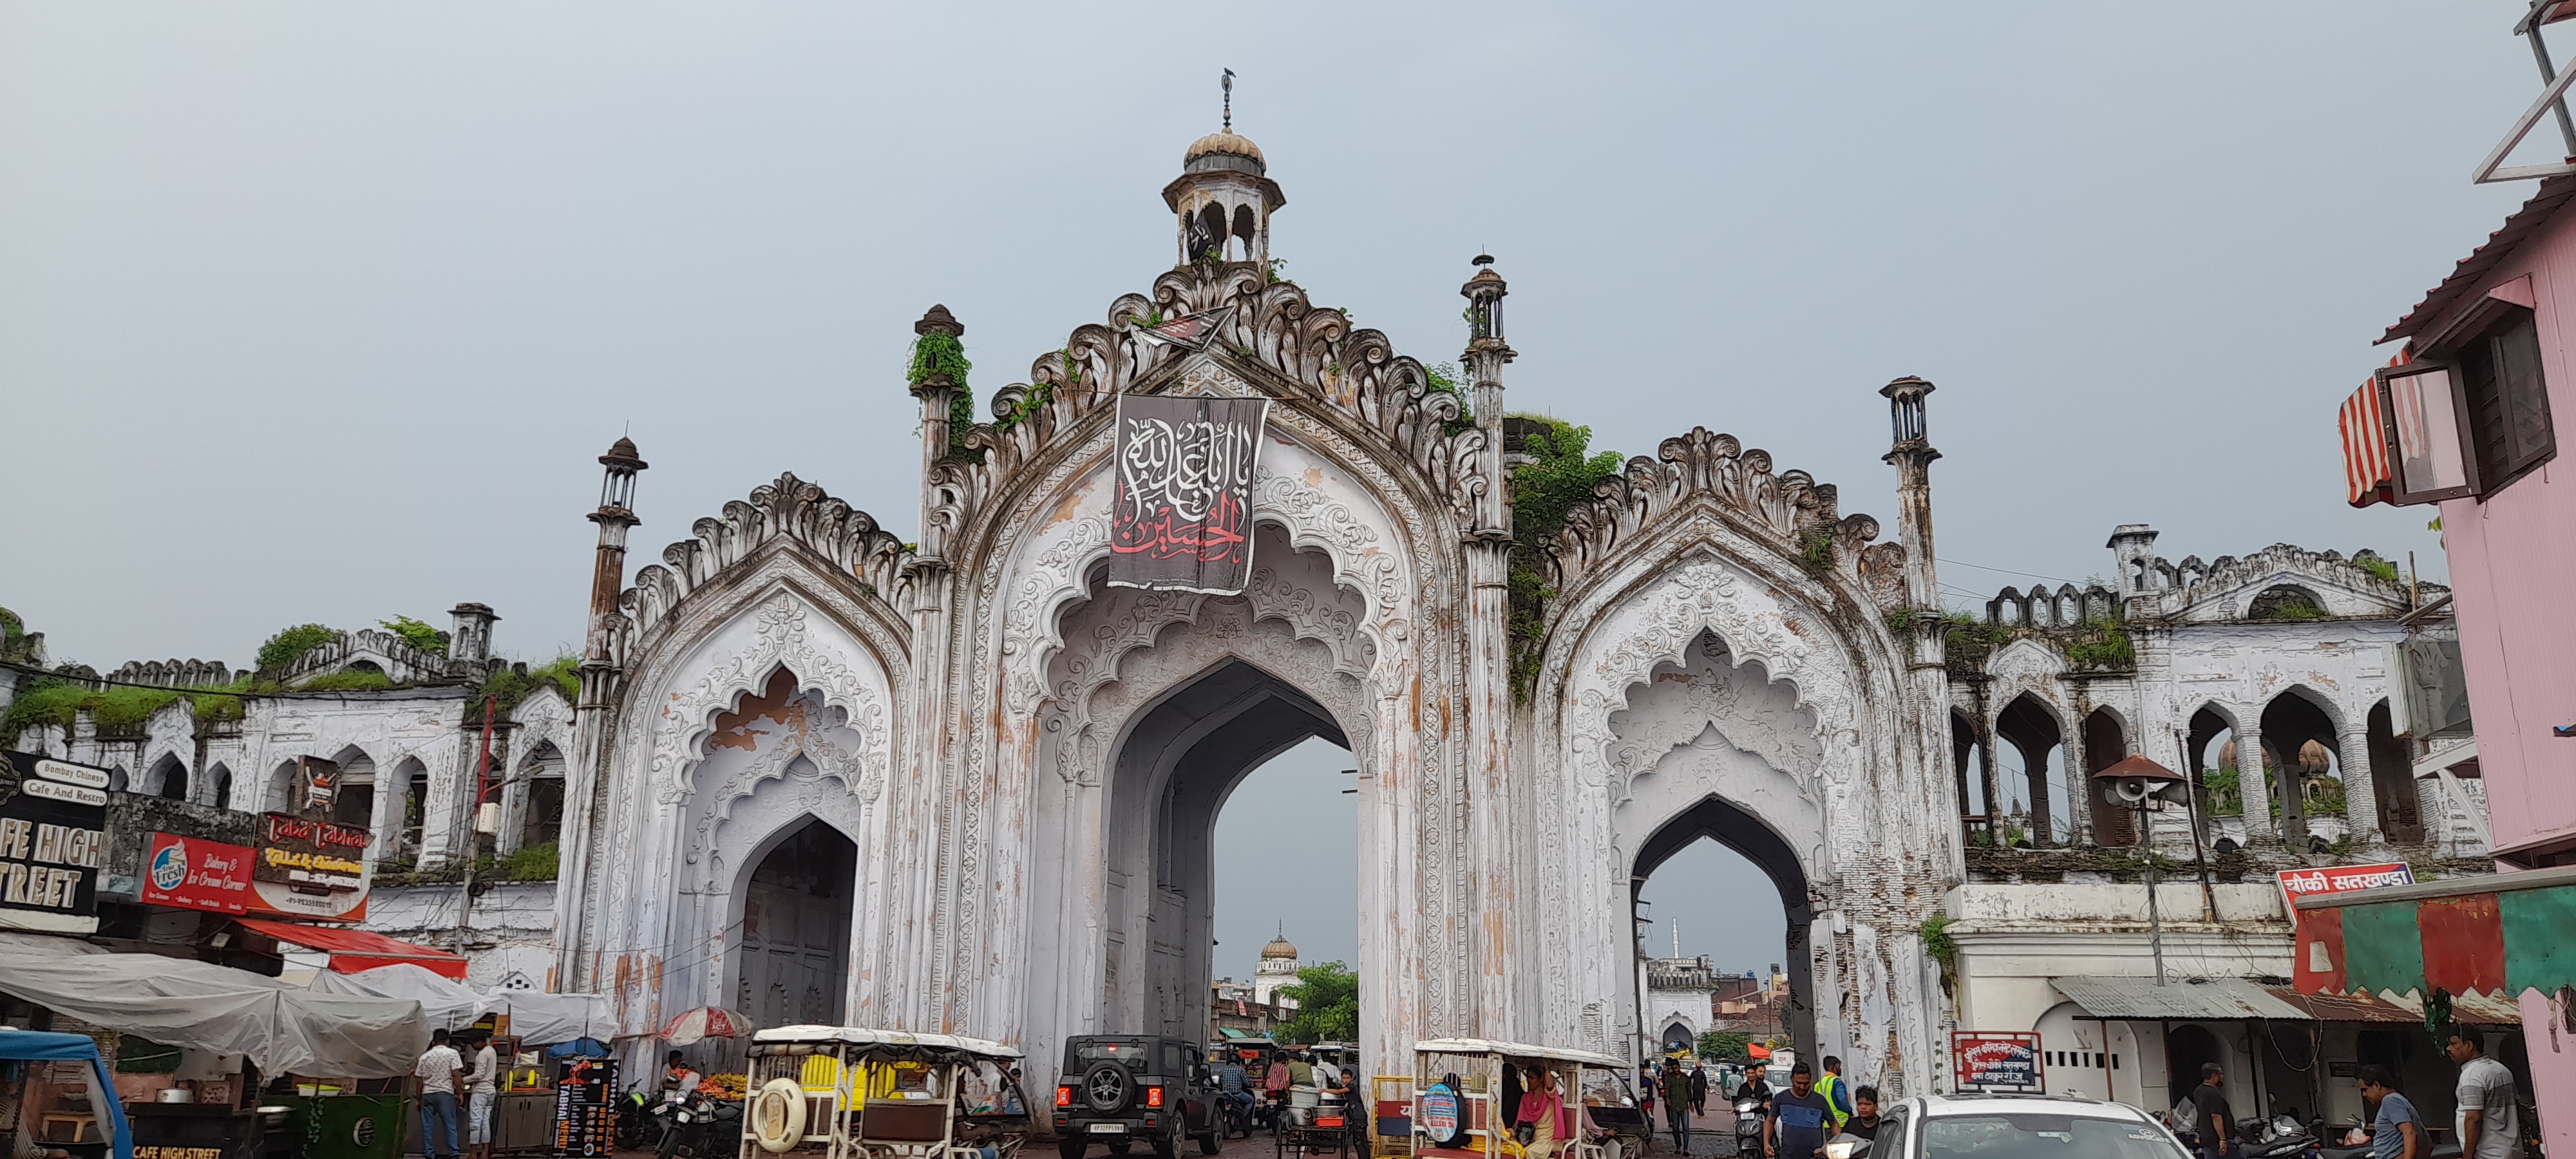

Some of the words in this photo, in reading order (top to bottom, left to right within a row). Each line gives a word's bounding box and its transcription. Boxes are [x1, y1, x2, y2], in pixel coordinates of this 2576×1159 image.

[44, 763, 74, 778] Bombay
[76, 769, 104, 783] Chinese
[29, 783, 50, 795] Cafe
[53, 786, 73, 798] And
[76, 790, 105, 804] Restro
[0, 818, 32, 860] FE
[33, 823, 104, 869] HIGH
[154, 863, 185, 883] Fresh
[198, 871, 222, 888] Cream
[222, 874, 247, 891] Corner
[2283, 871, 2329, 895] चौकी
[2331, 870, 2407, 890] सतखण्डा
[0, 862, 82, 909] TREET
[607, 1060, 620, 1113] TABHAI
[557, 1084, 571, 1120] TABHAI
[558, 1120, 570, 1149] MENU
[2128, 1133, 2172, 1144] ADVOCATE
[132, 1146, 159, 1159] CAFE
[160, 1147, 185, 1159] HIGH
[185, 1147, 222, 1159] STREET
